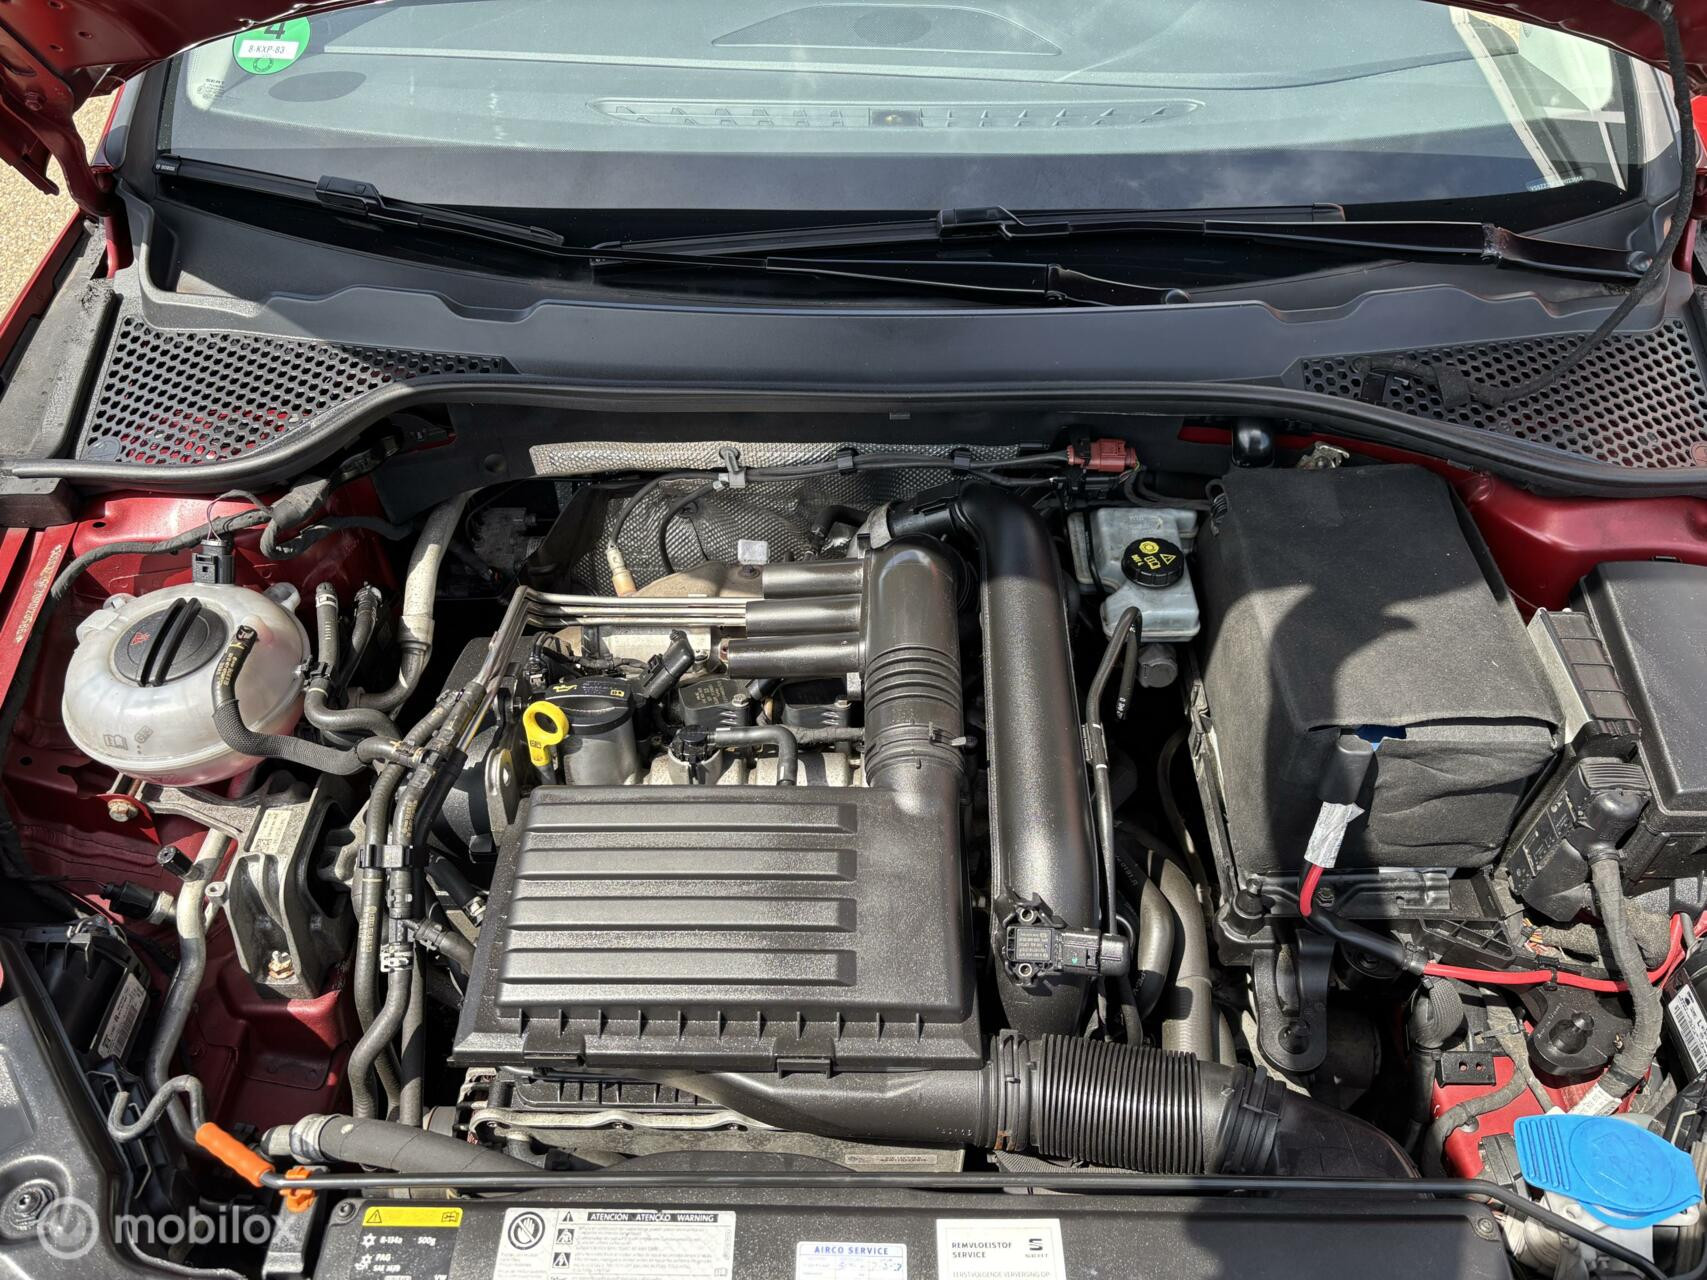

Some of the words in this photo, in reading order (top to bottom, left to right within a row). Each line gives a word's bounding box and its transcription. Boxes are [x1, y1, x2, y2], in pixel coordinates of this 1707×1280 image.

[264, 21, 286, 39] 4
[677, 1214, 714, 1222] WARNING
[814, 1246, 844, 1254] AIRCO
[848, 1246, 889, 1255] SERVICE
